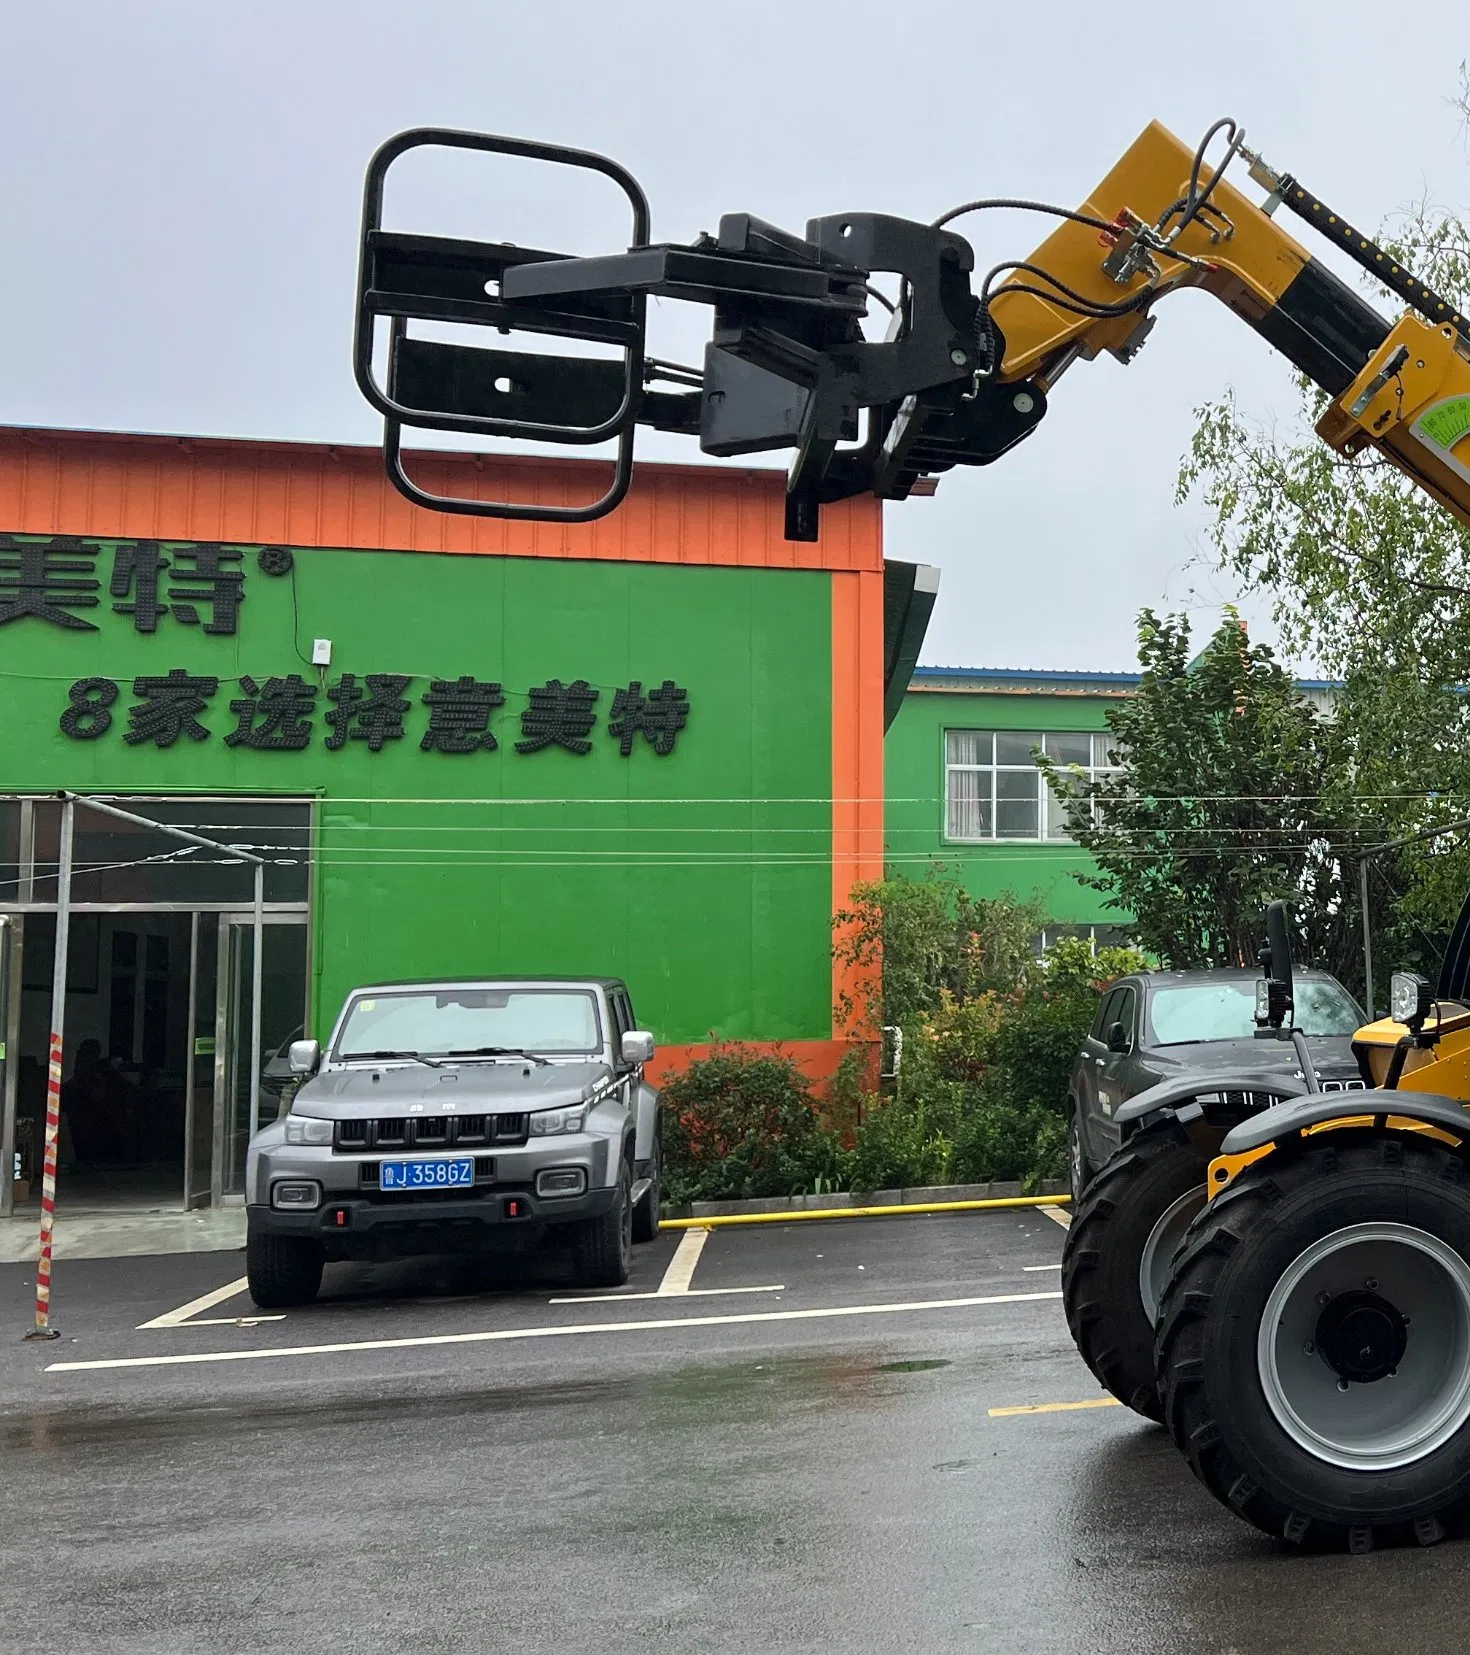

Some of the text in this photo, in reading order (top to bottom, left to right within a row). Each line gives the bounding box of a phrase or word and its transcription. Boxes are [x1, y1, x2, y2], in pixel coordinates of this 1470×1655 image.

[59, 669, 690, 757] 8家选择意美特
